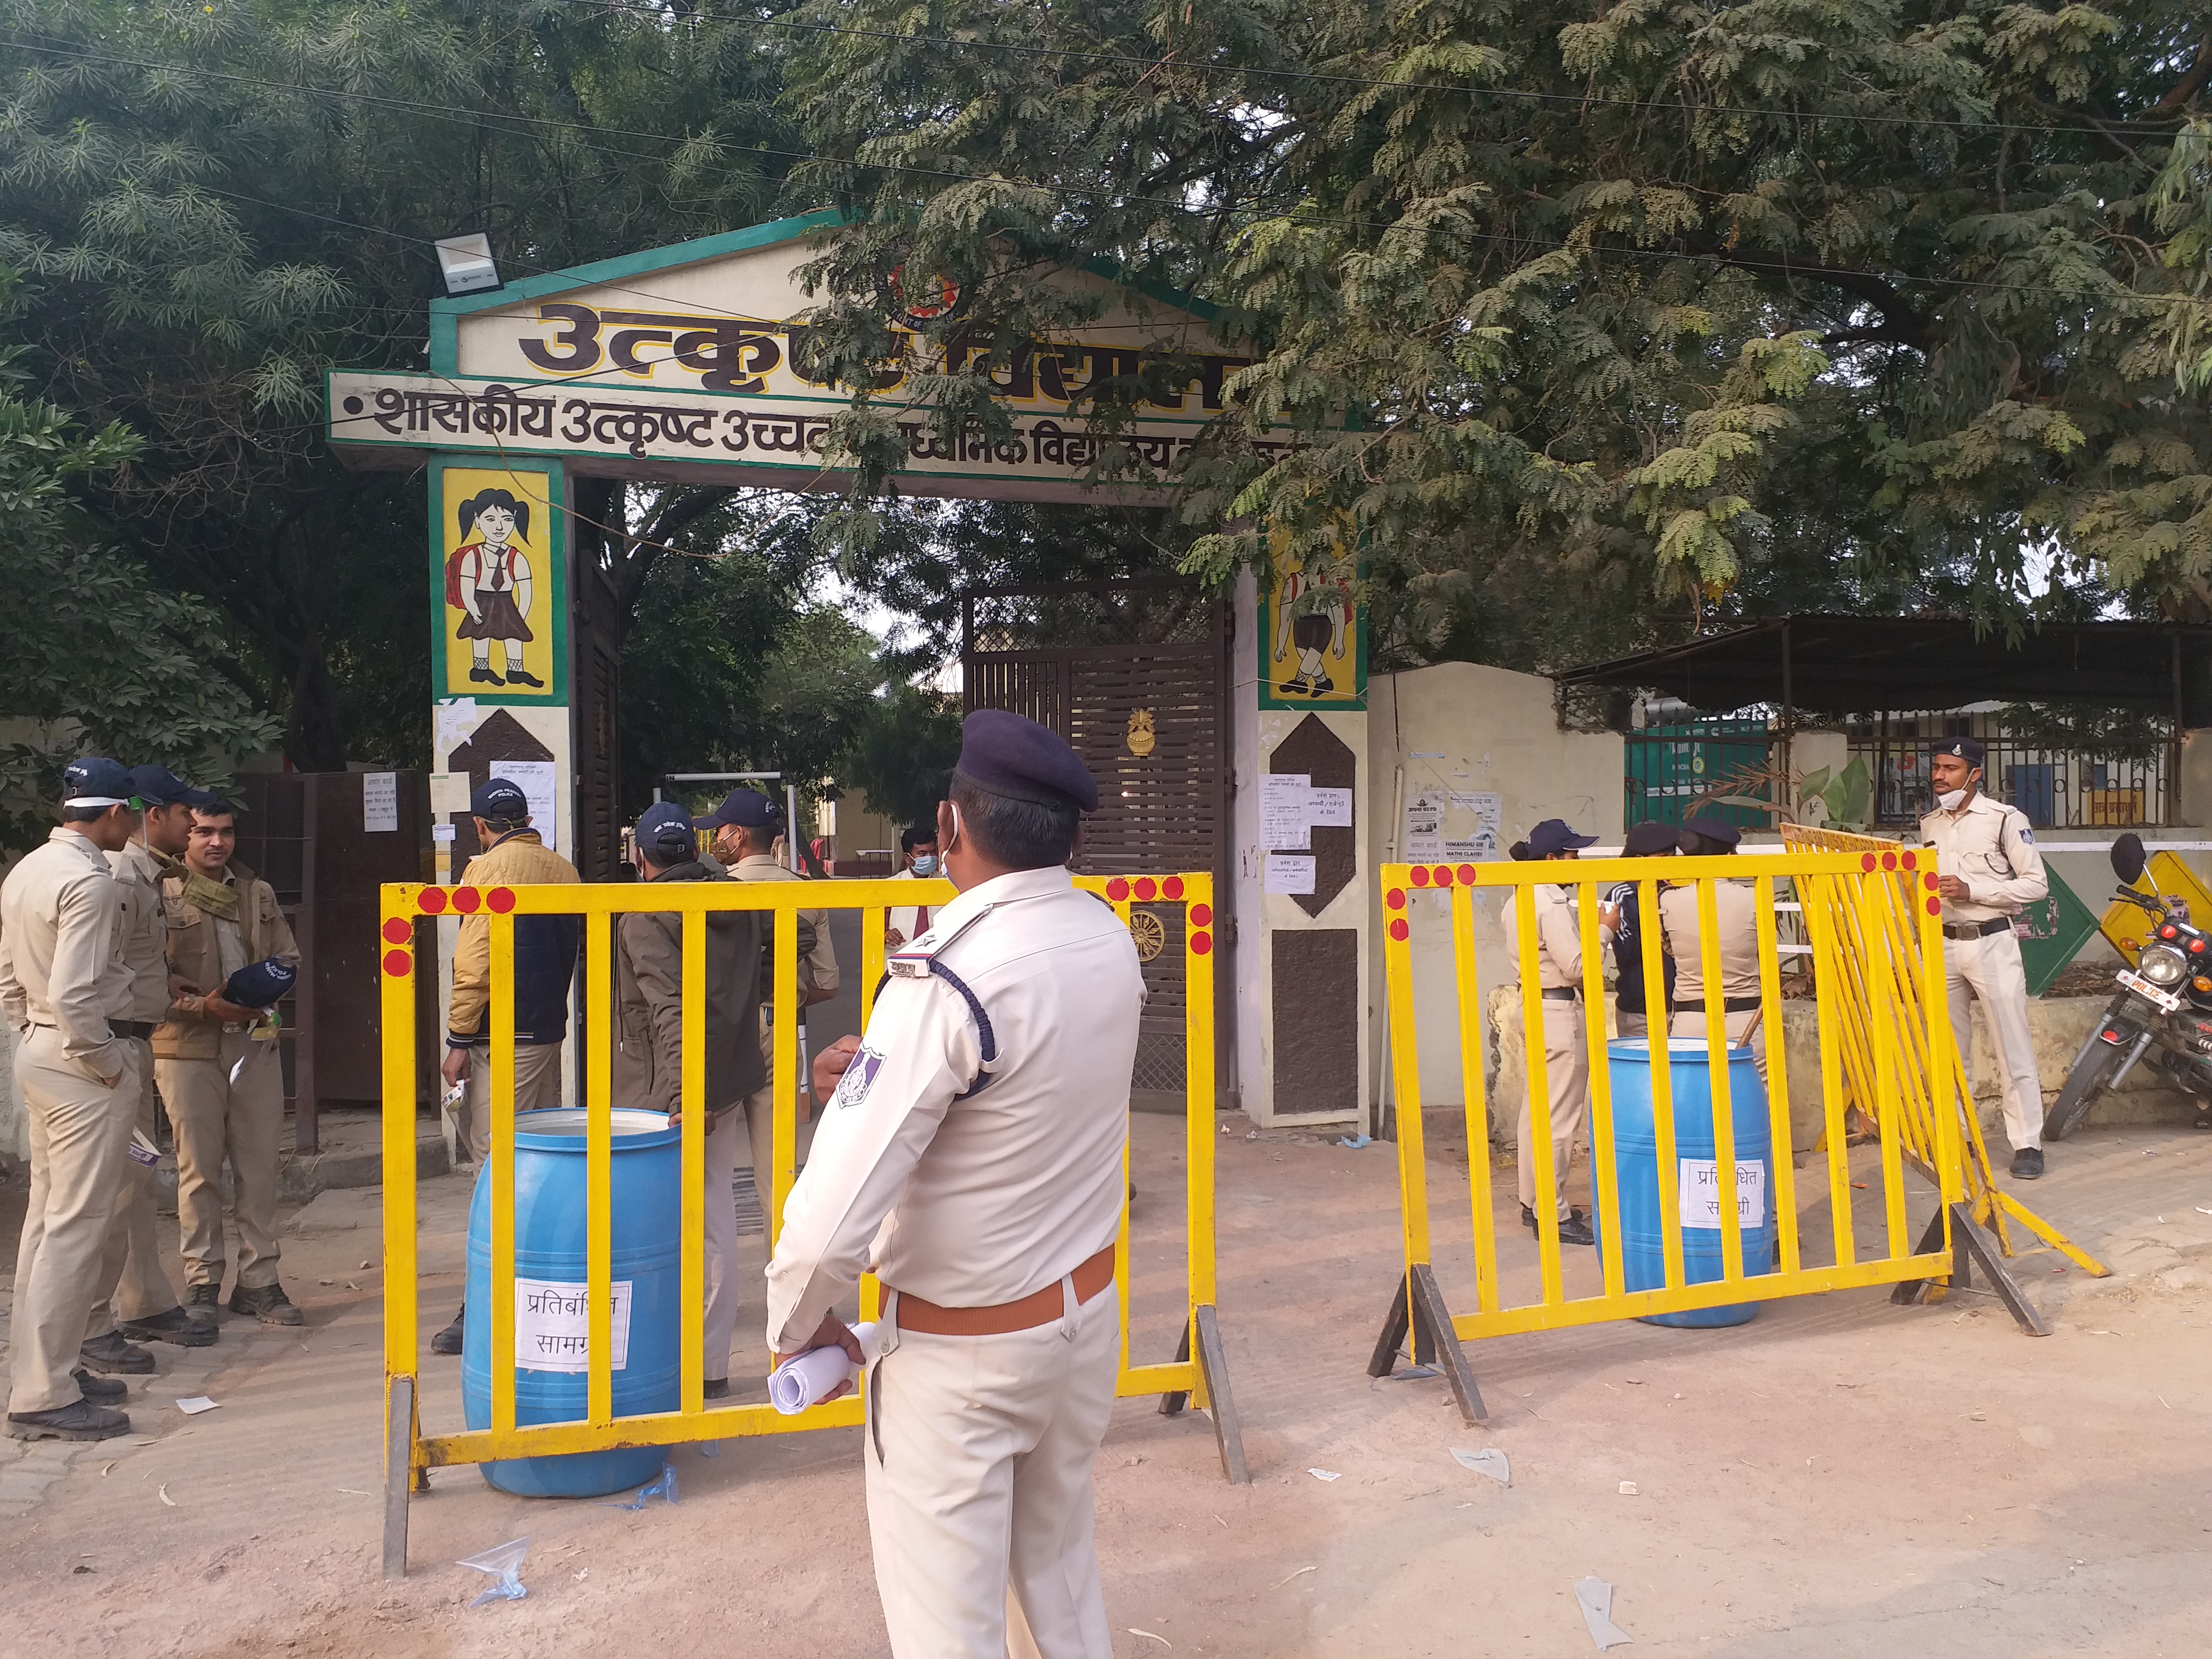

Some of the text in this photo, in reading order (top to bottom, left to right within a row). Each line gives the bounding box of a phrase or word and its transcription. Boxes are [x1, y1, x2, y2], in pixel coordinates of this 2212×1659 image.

[374, 384, 557, 437] शासकीय
[561, 399, 719, 458] उत्कृष्ट
[2131, 980, 2163, 1000] POLICE
